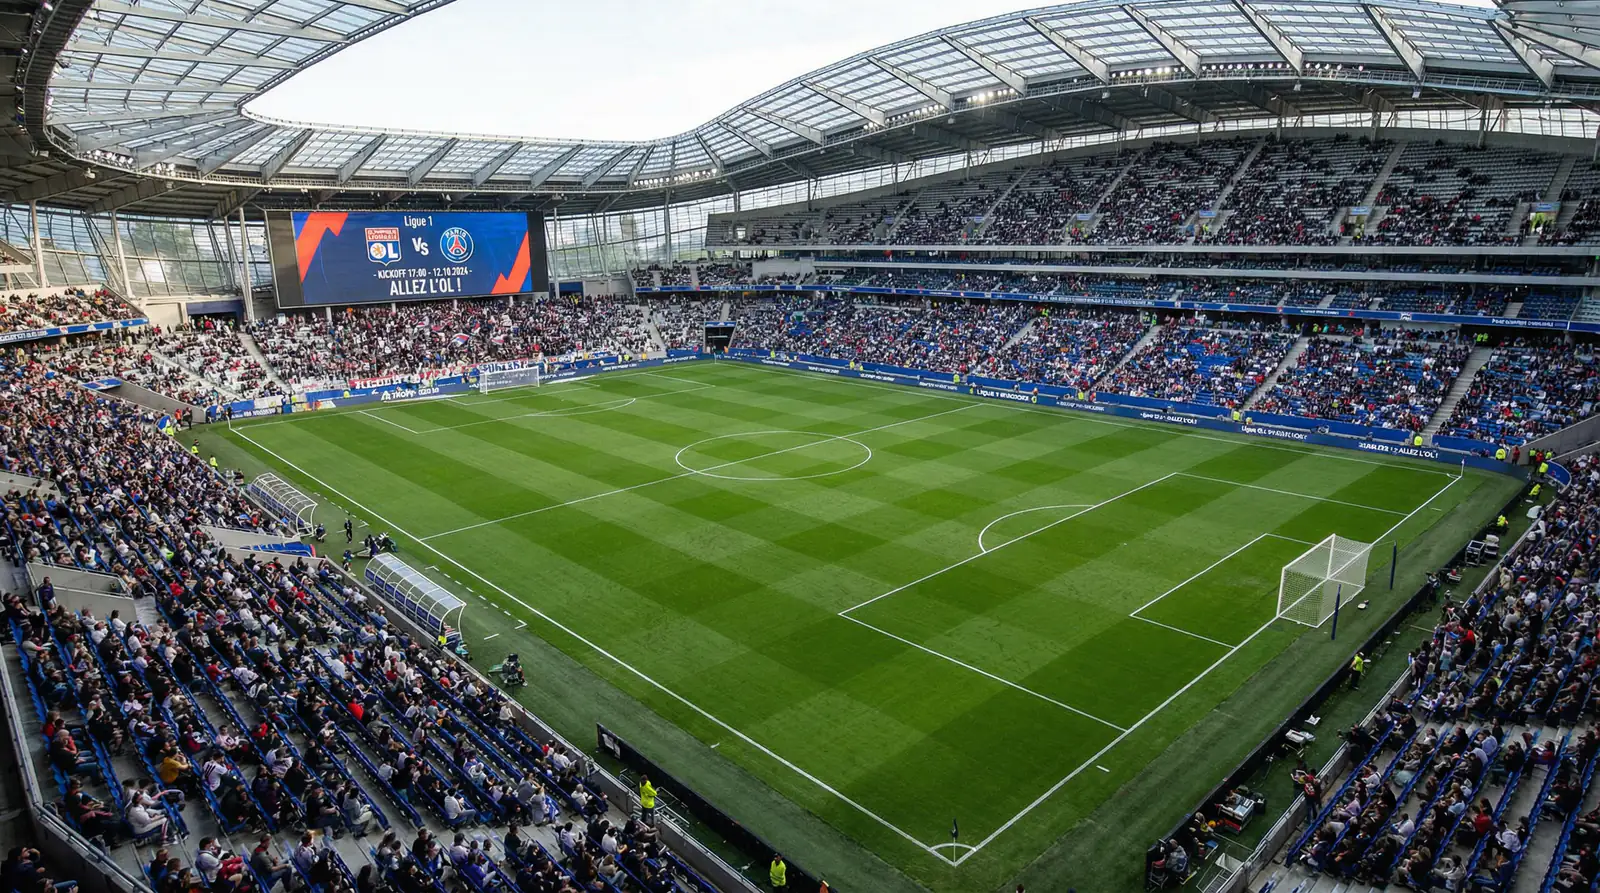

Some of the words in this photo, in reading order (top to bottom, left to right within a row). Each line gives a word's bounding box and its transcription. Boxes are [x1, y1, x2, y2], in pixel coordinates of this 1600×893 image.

[404, 216, 426, 229] Ligue
[428, 216, 433, 226] 1
[378, 269, 406, 279] KICKOFF
[408, 268, 426, 277] 17:00
[390, 279, 427, 296] ALLEZ
[430, 278, 454, 293] L'OL
[1398, 447, 1418, 456] ALLEZ
